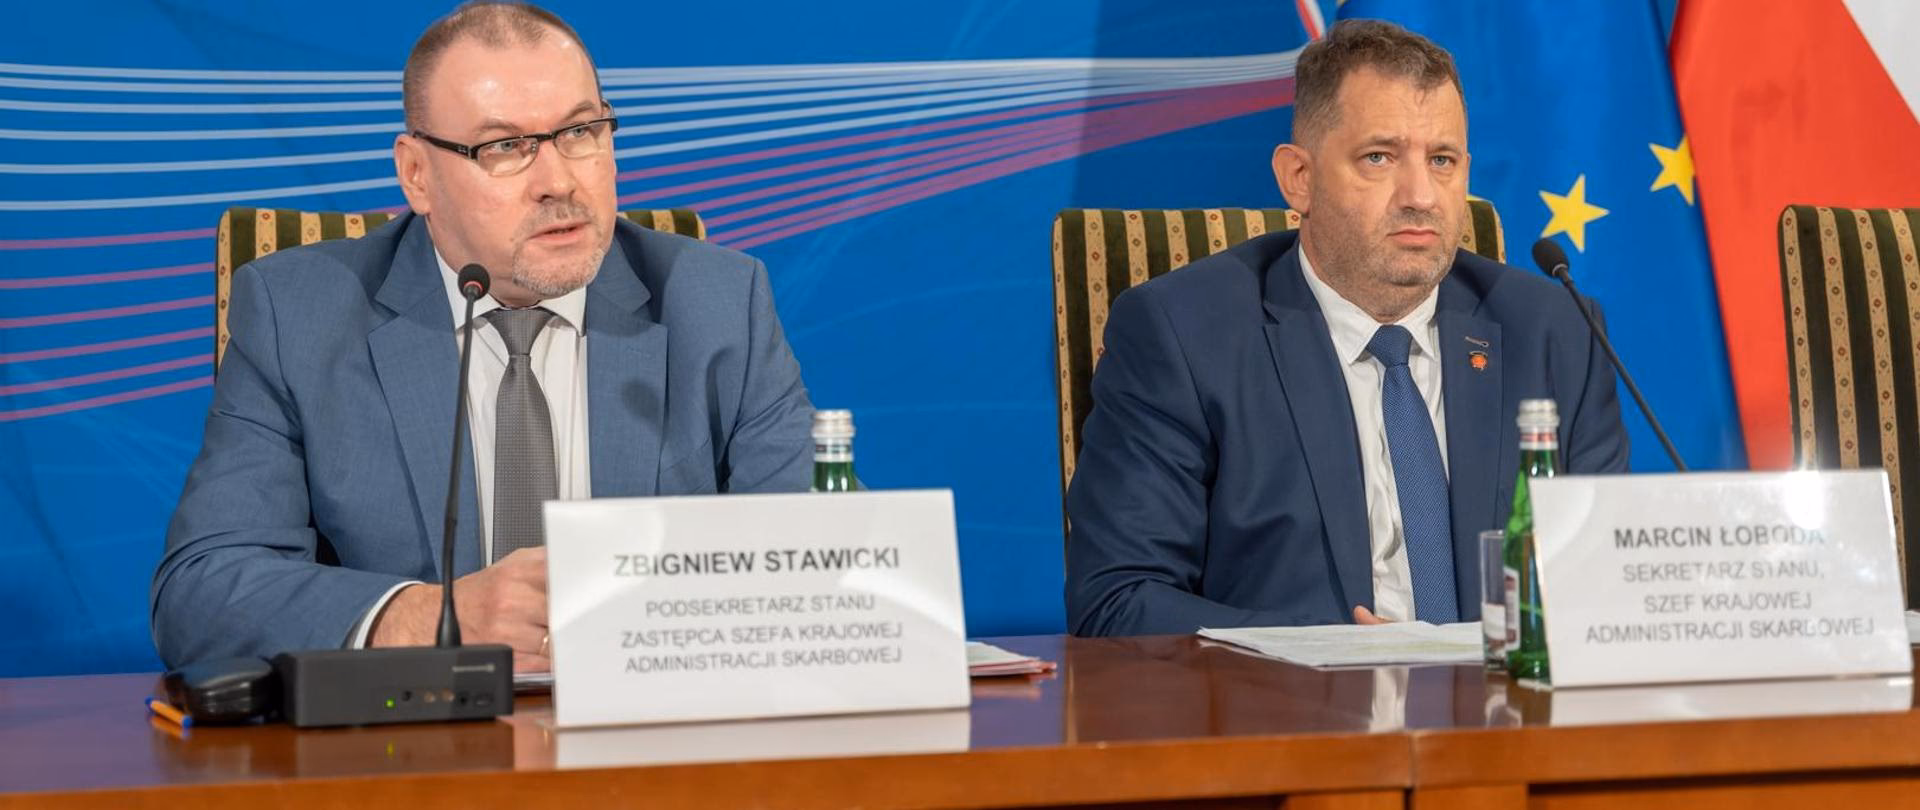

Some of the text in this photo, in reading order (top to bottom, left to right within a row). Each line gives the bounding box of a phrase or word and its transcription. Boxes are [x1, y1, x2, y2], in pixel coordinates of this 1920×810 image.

[1614, 525, 1825, 548] MARCIN ŁOBODA
[614, 548, 899, 576] ZBIGNIEW STAWICKI
[1623, 562, 1745, 583] SEKRETARZ
[646, 594, 874, 617] PODSEKRETARZ STANU
[1644, 592, 1812, 614] SZEF KRAJOWEJ
[622, 622, 902, 649] ZASTĘPCA SZEFA KRAJOWEJ
[1586, 622, 1744, 643] ADMINISTRACJI
[625, 646, 902, 673] ADMINISTRACJI SKARBOWEJ
